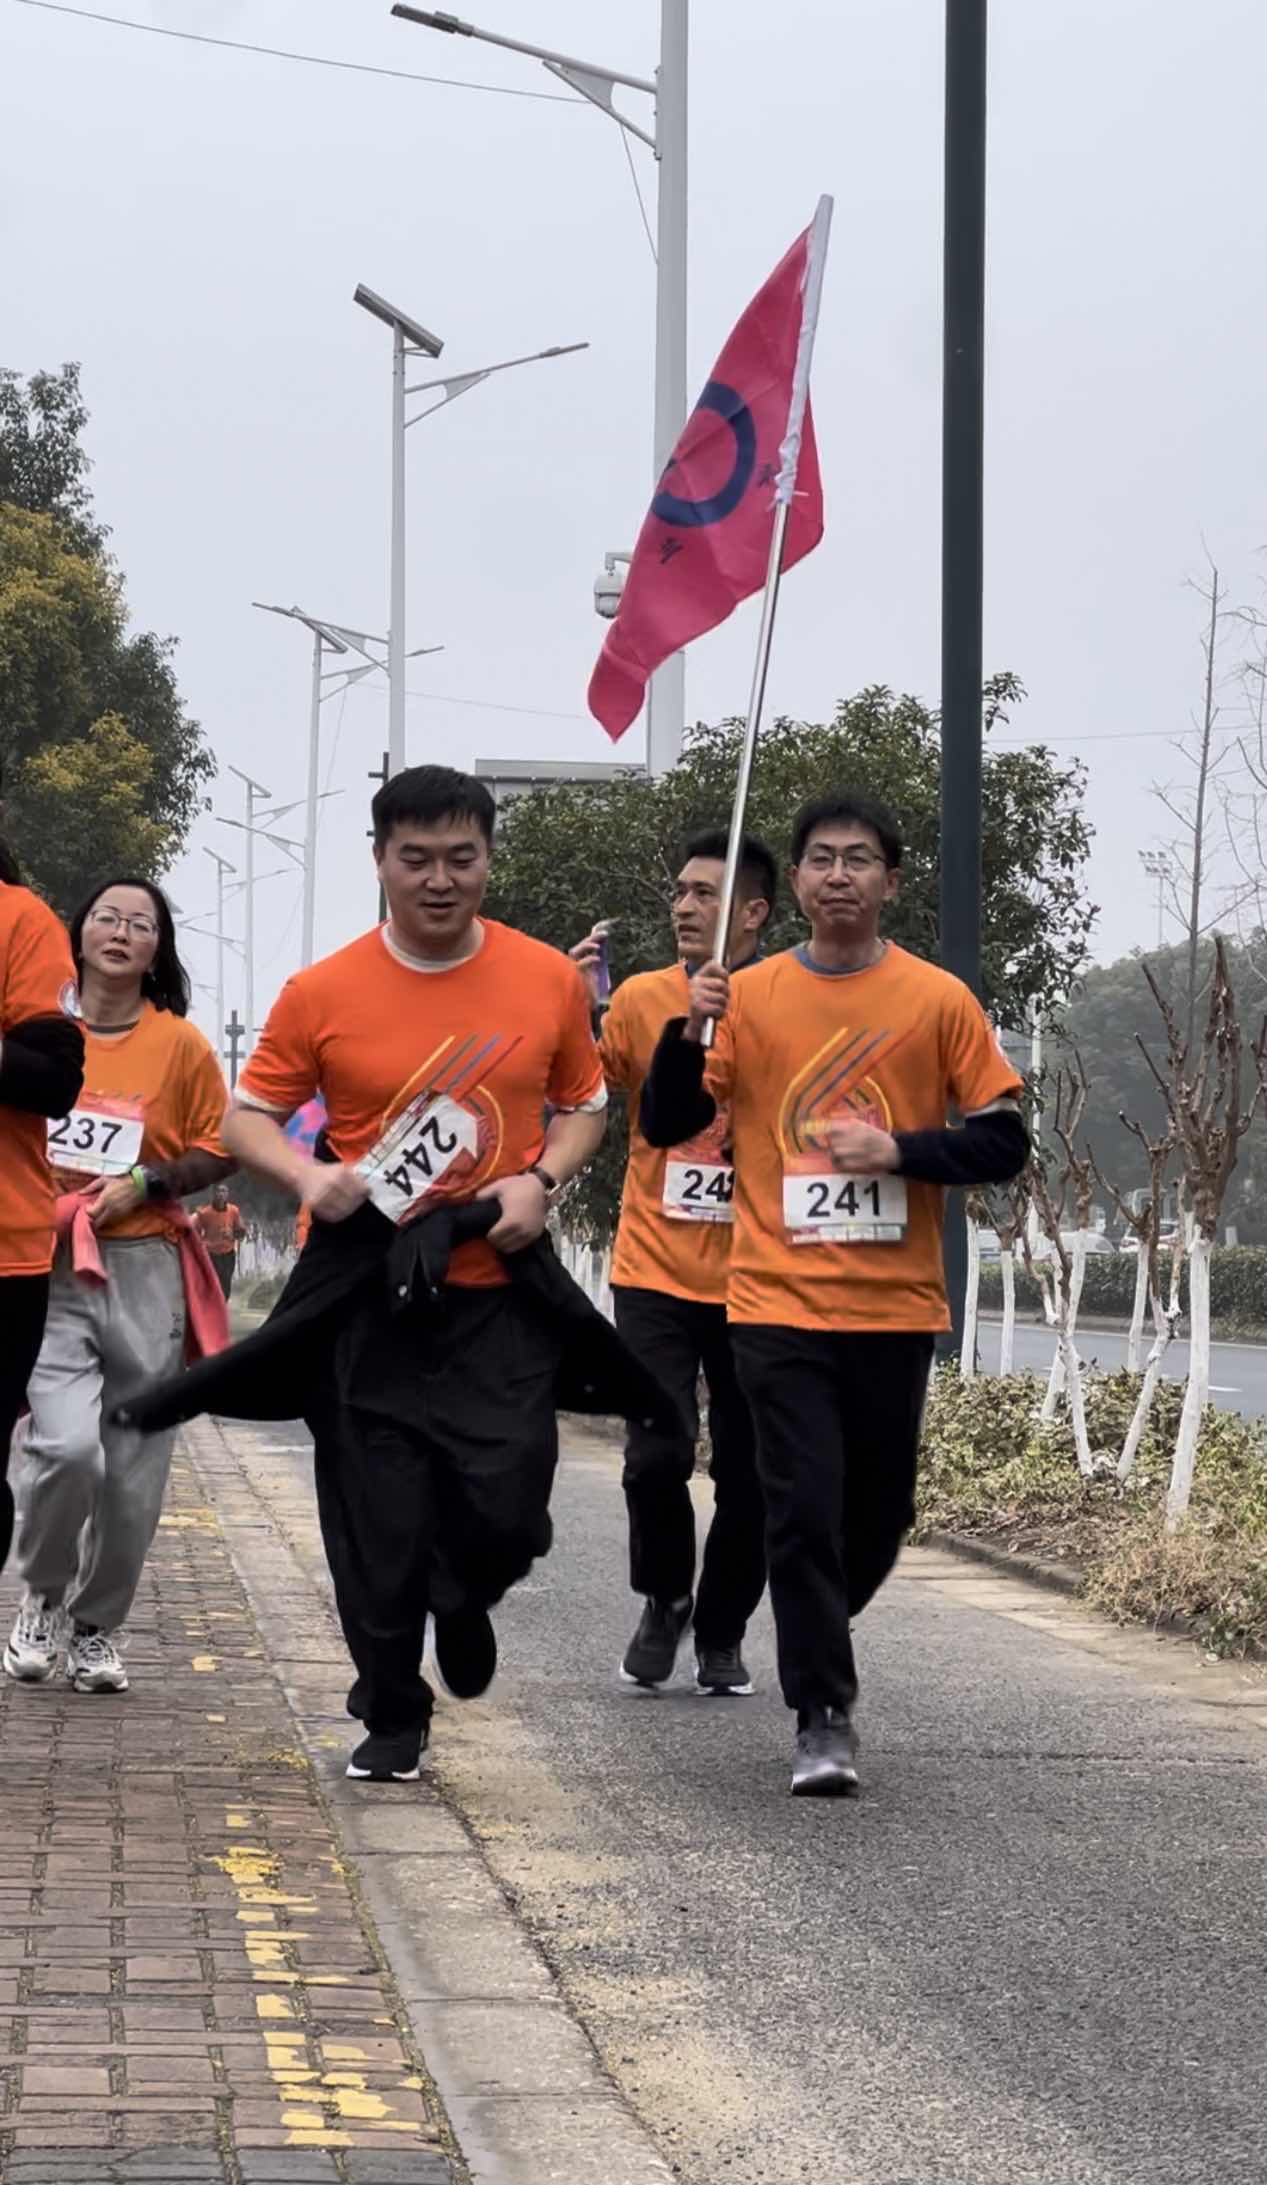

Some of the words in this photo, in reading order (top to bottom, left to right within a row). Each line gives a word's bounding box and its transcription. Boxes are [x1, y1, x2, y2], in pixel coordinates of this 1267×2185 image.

[47, 1115, 123, 1153] 237
[383, 1116, 457, 1197] 244
[806, 1179, 881, 1218] 241
